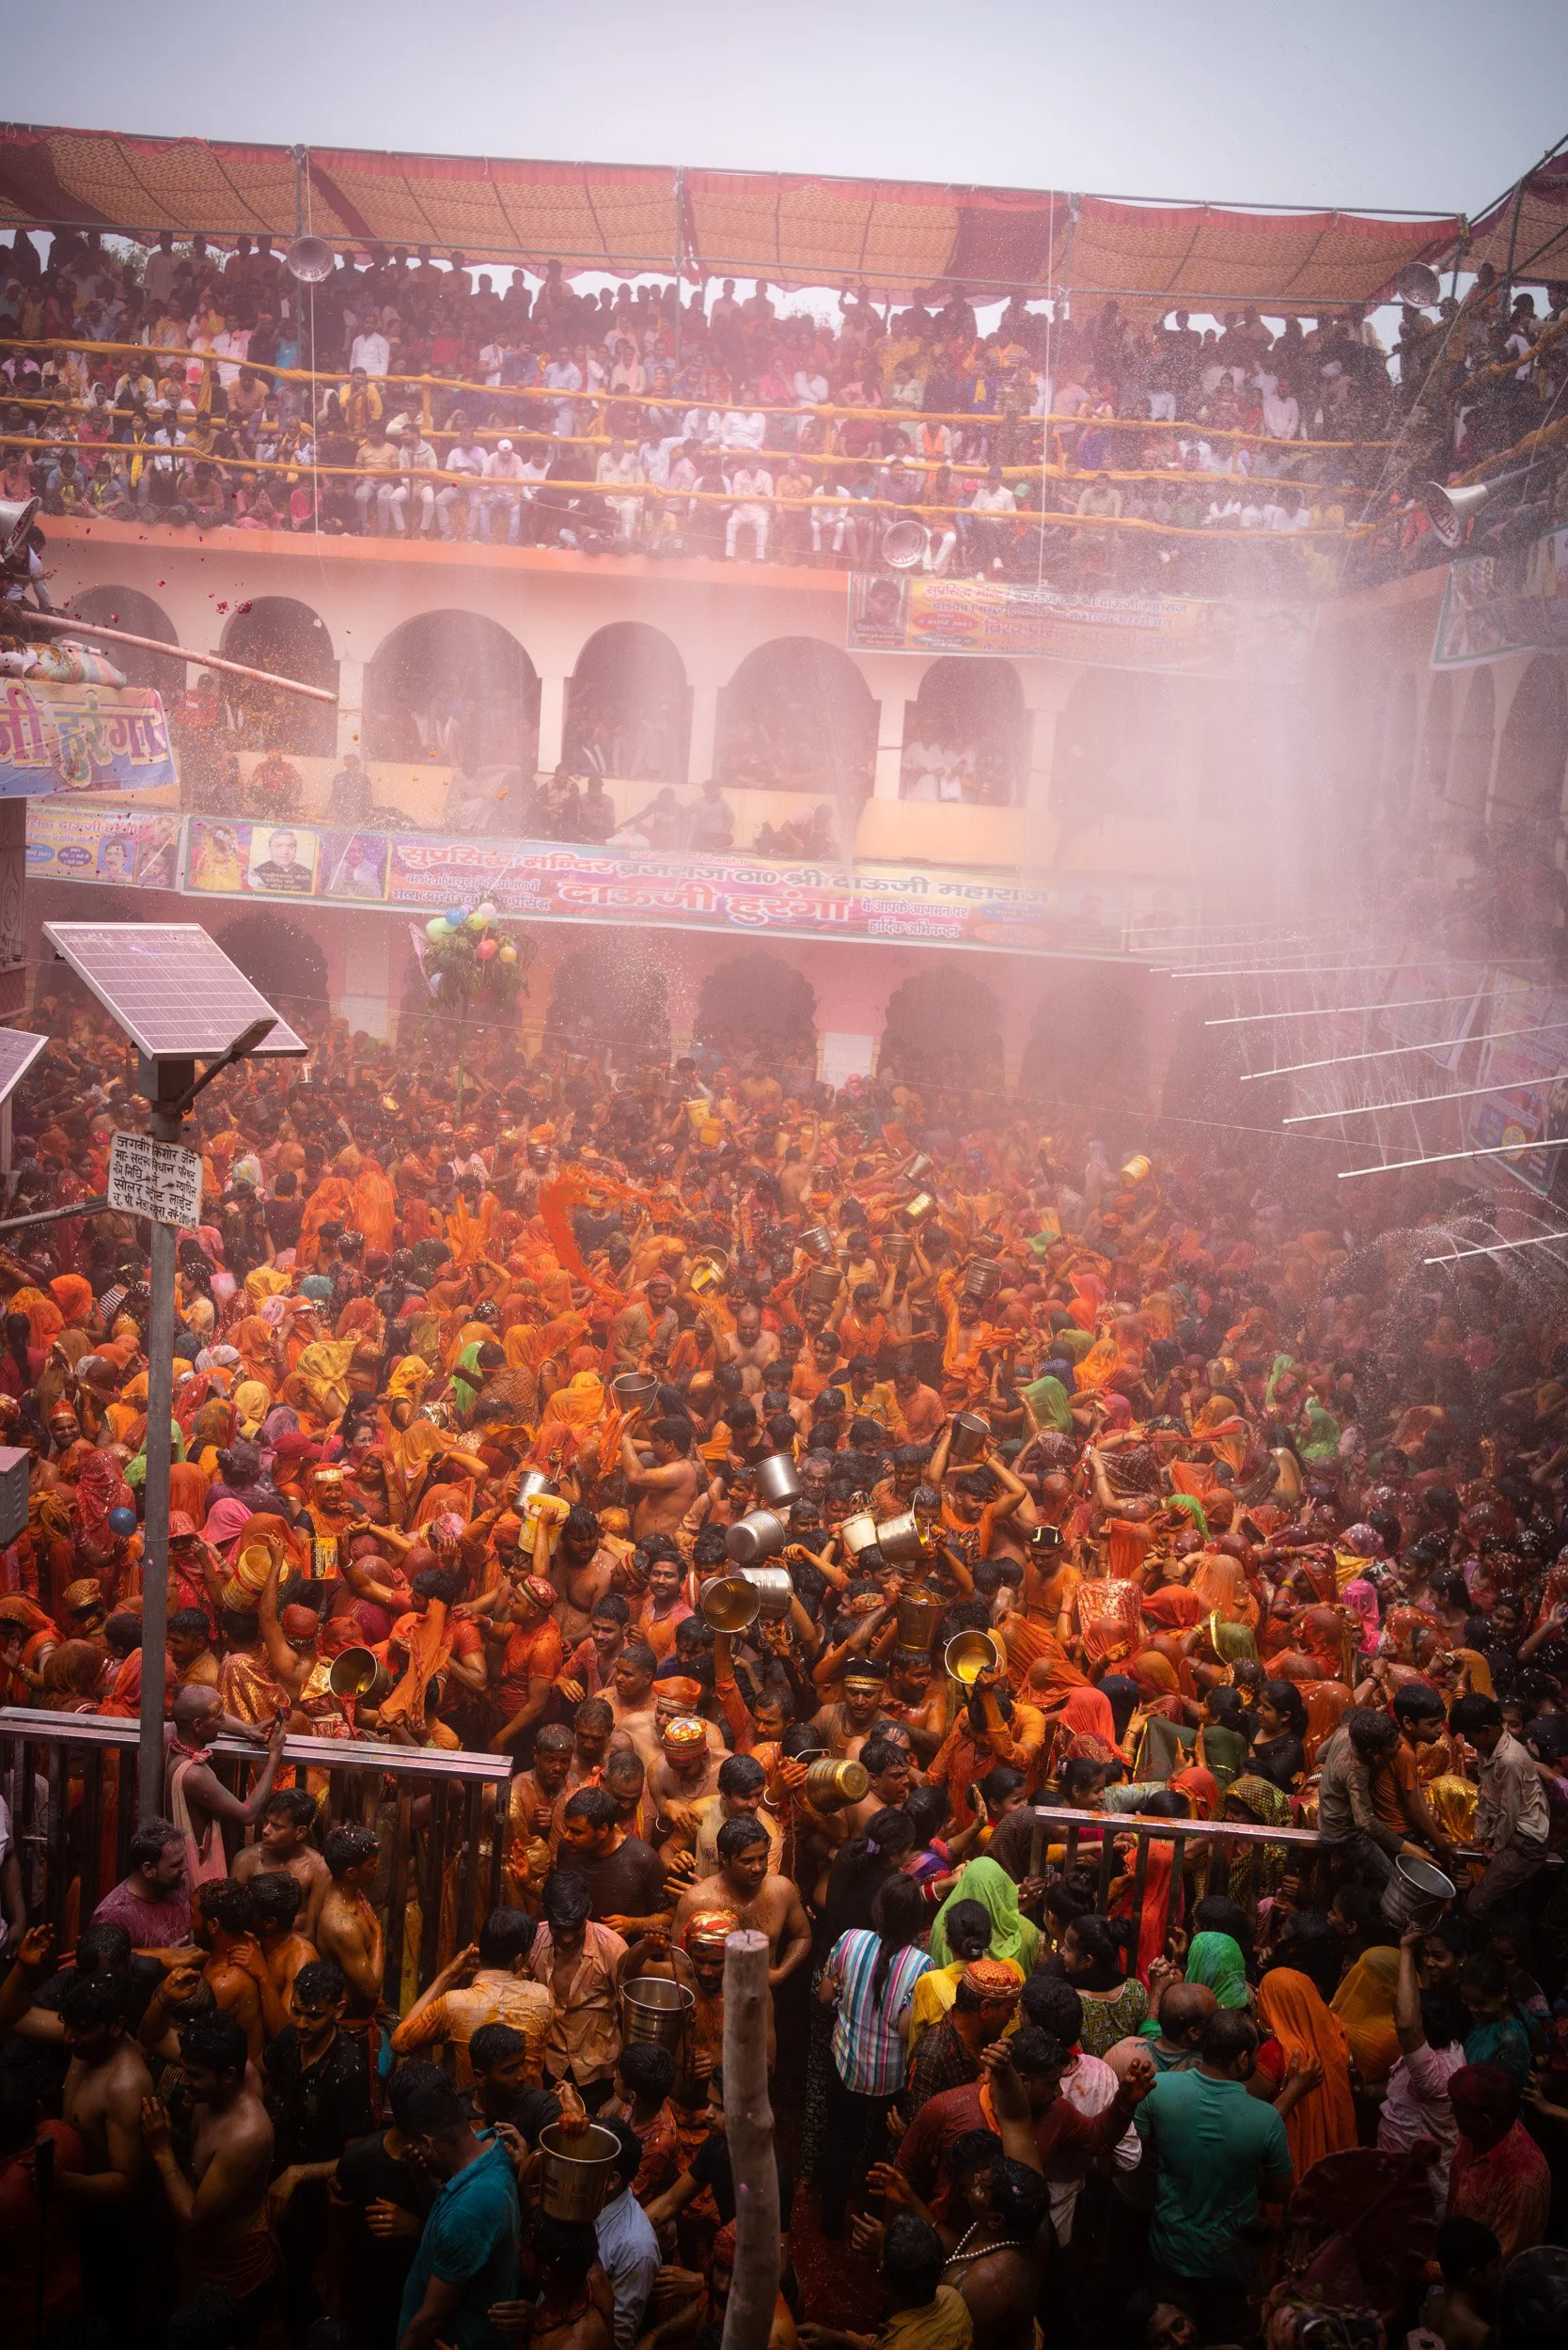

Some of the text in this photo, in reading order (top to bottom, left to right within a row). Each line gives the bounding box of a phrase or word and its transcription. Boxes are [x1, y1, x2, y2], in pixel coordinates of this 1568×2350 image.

[54, 696, 169, 785] हुरंगा
[521, 853, 613, 873] मन्दिर
[783, 868, 825, 888] श्री
[832, 875, 931, 895] दाऊजी
[937, 883, 1051, 904] महाराज
[559, 882, 850, 924] दाऊजी हुरंगा
[874, 899, 908, 914] आपके
[909, 903, 949, 917] आगमन
[951, 906, 969, 918] पर
[117, 1136, 151, 1152] जगवीर
[152, 1143, 179, 1162] किशोर
[113, 1160, 123, 1176] की
[124, 1164, 143, 1180] निधि
[131, 1152, 151, 1167] सदस्य
[151, 1158, 176, 1175] विधान
[113, 1176, 144, 1195] सोलर
